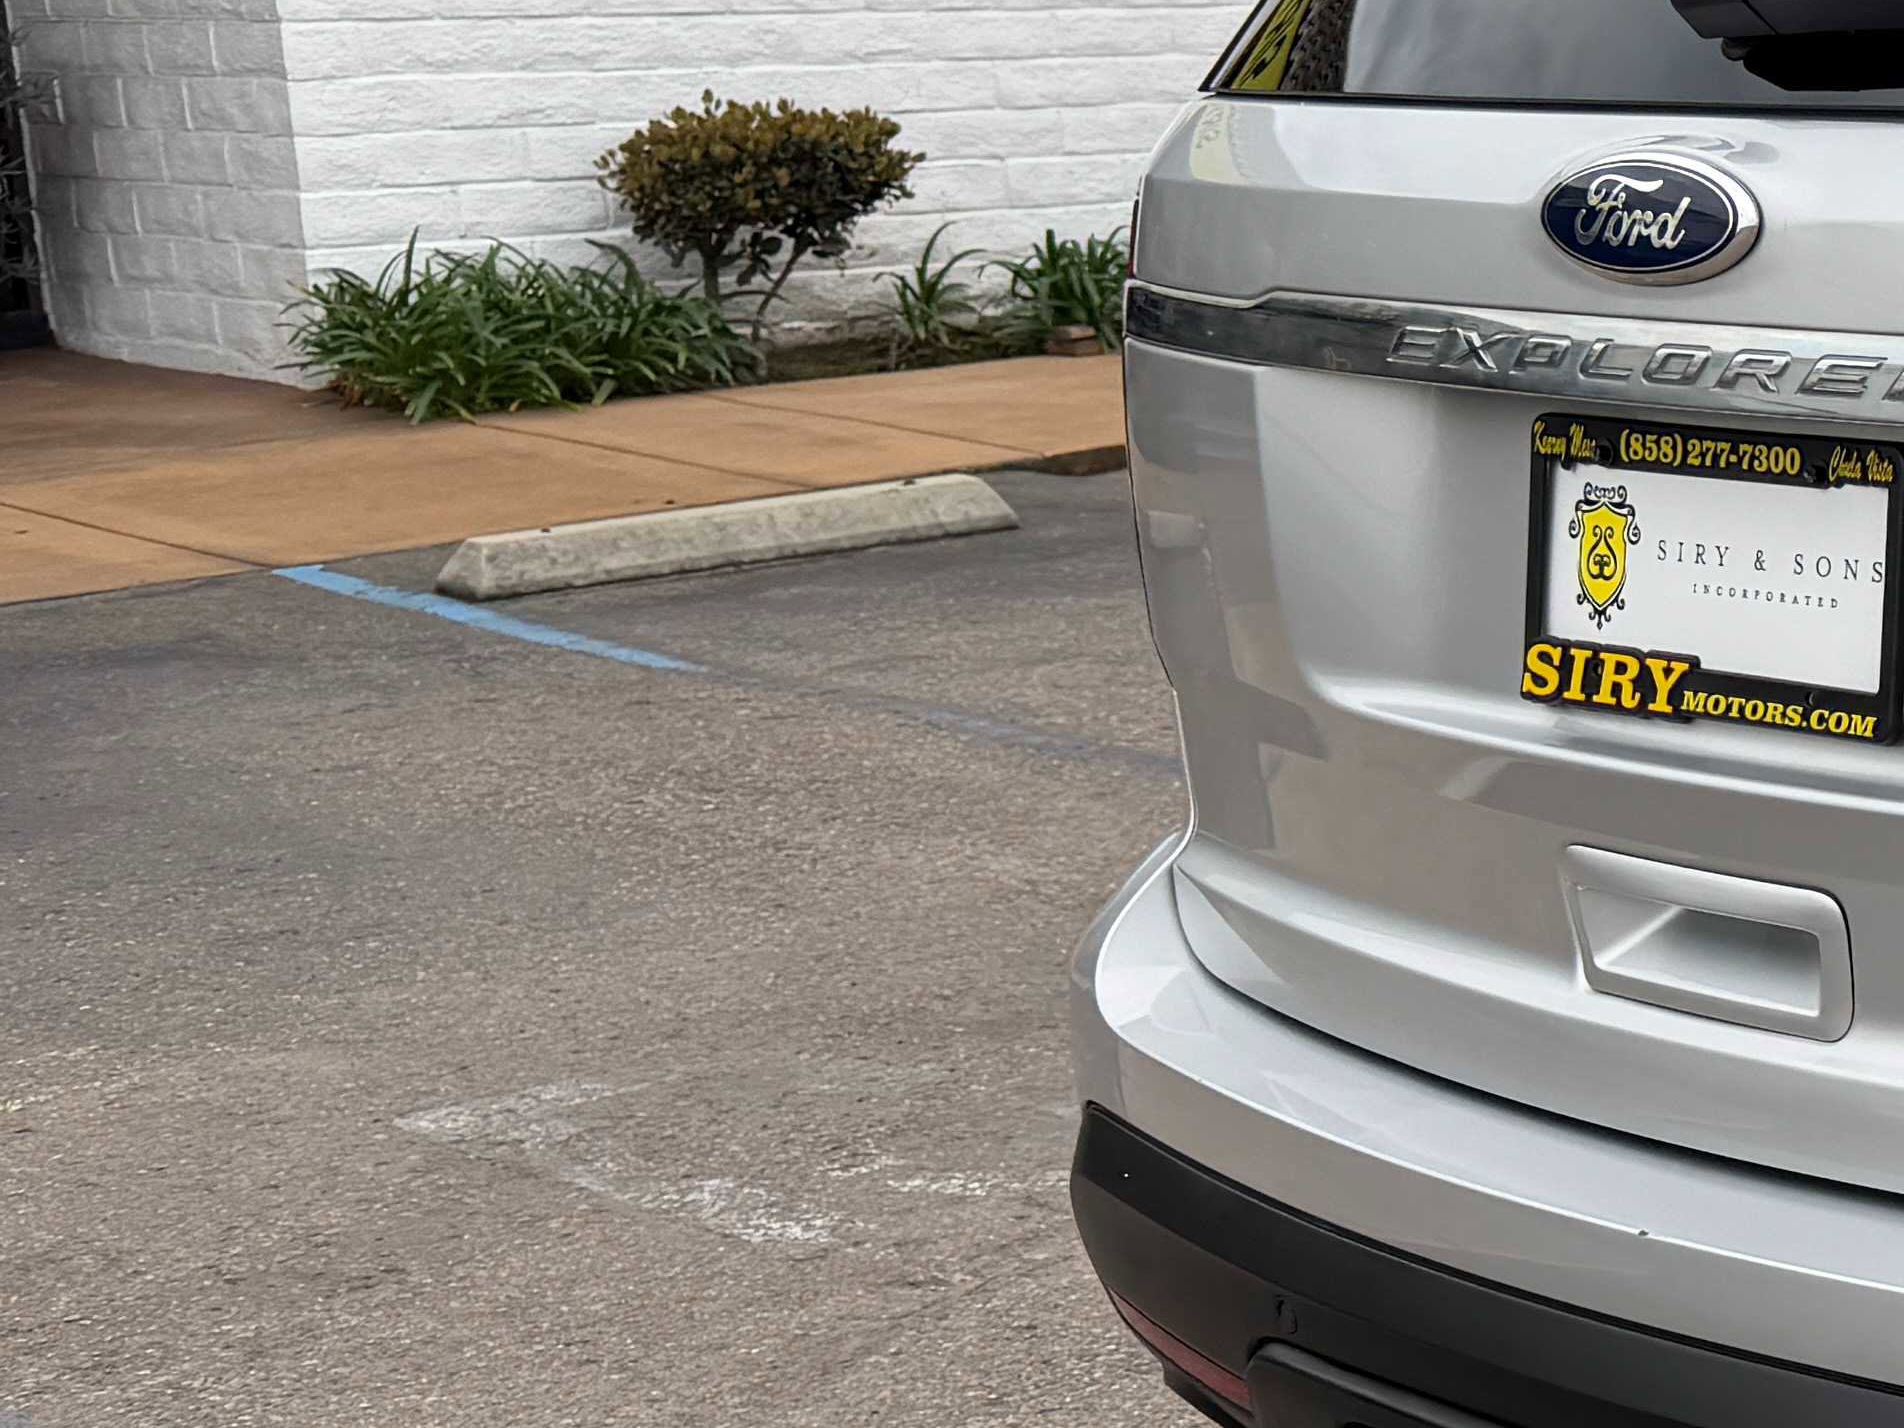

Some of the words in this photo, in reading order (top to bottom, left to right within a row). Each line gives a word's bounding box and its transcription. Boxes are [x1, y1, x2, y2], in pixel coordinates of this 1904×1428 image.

[1574, 173, 1691, 251] Ford
[1619, 428, 1683, 468] (858)
[1686, 435, 1802, 476] 277-7300
[1656, 538, 1730, 569] SIRY
[1754, 549, 1768, 572] &
[1792, 553, 1885, 584] SONS
[1692, 583, 1841, 610] INCORPORATED
[1522, 642, 1690, 716] SIRY
[1681, 689, 1878, 739] MOTORS.COM
